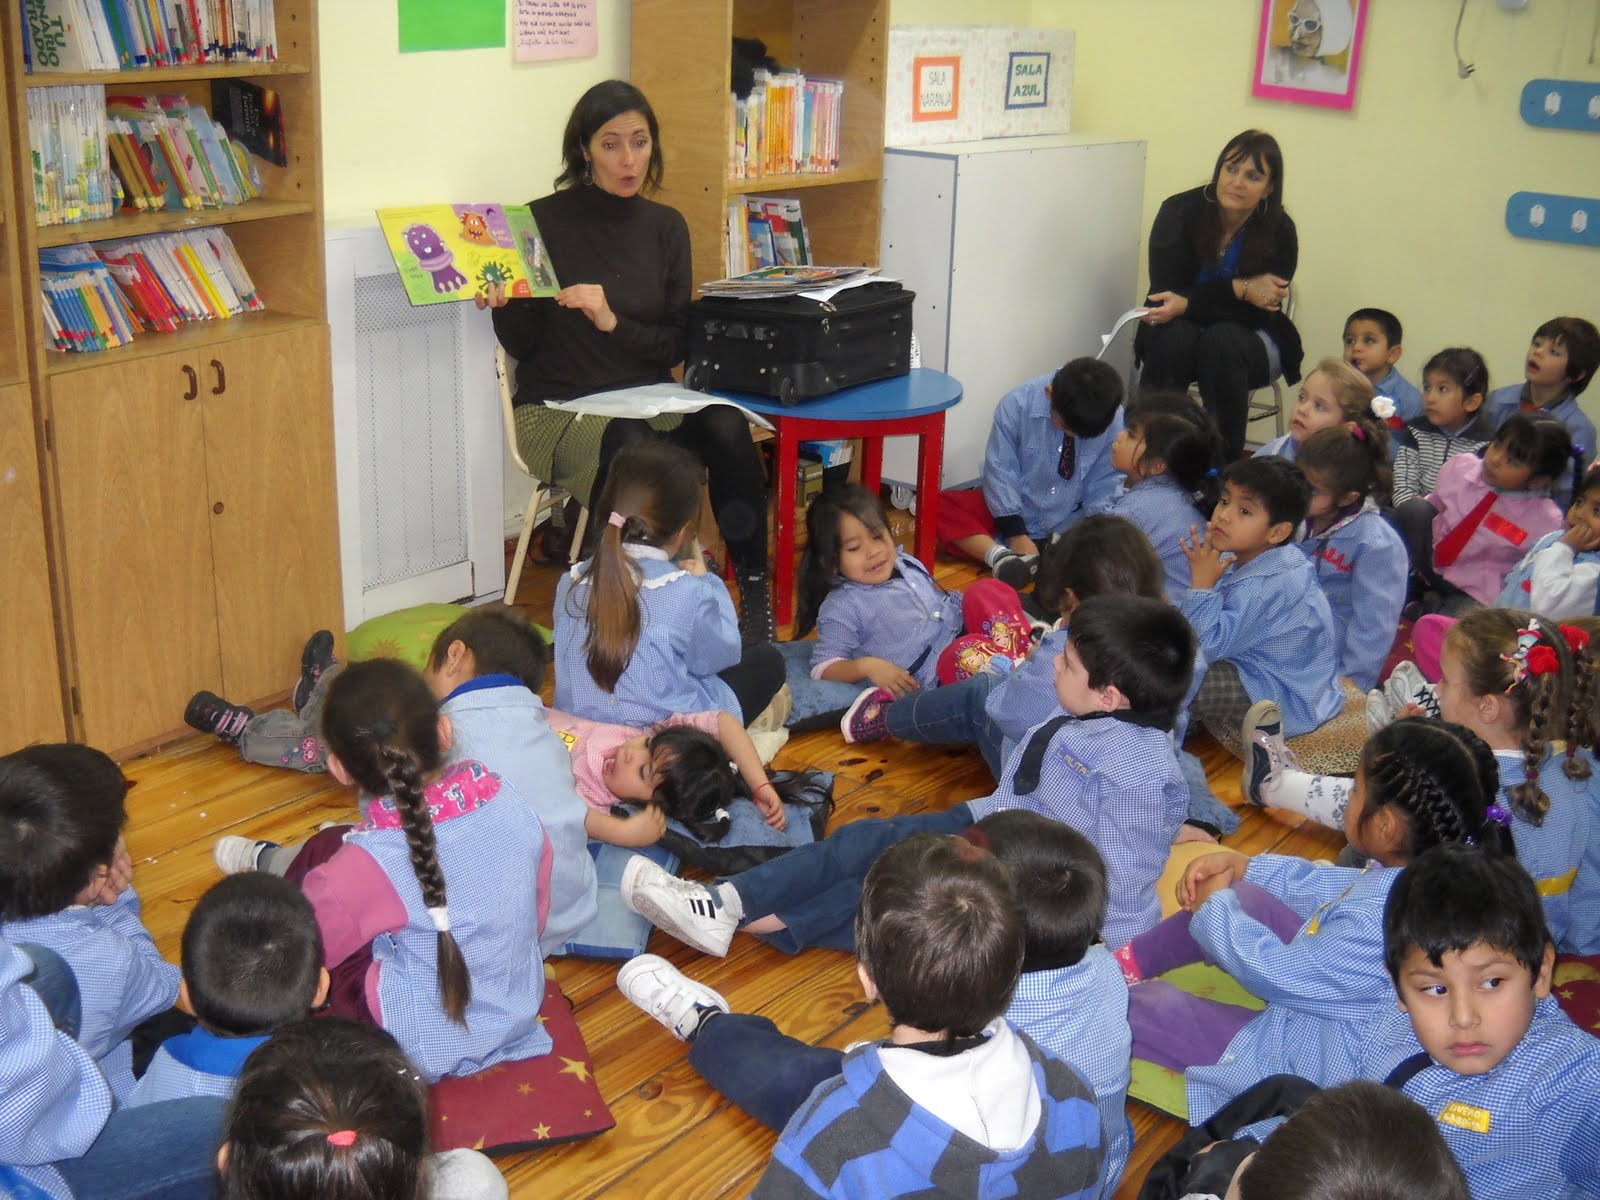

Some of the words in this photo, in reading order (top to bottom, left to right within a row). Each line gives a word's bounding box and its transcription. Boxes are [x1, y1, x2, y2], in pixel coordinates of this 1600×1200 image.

[50, 15, 66, 47] TU
[1015, 63, 1043, 77] SALA
[928, 71, 946, 86] SALA
[1013, 84, 1041, 97] AZUL
[920, 92, 952, 108] NARANJA
